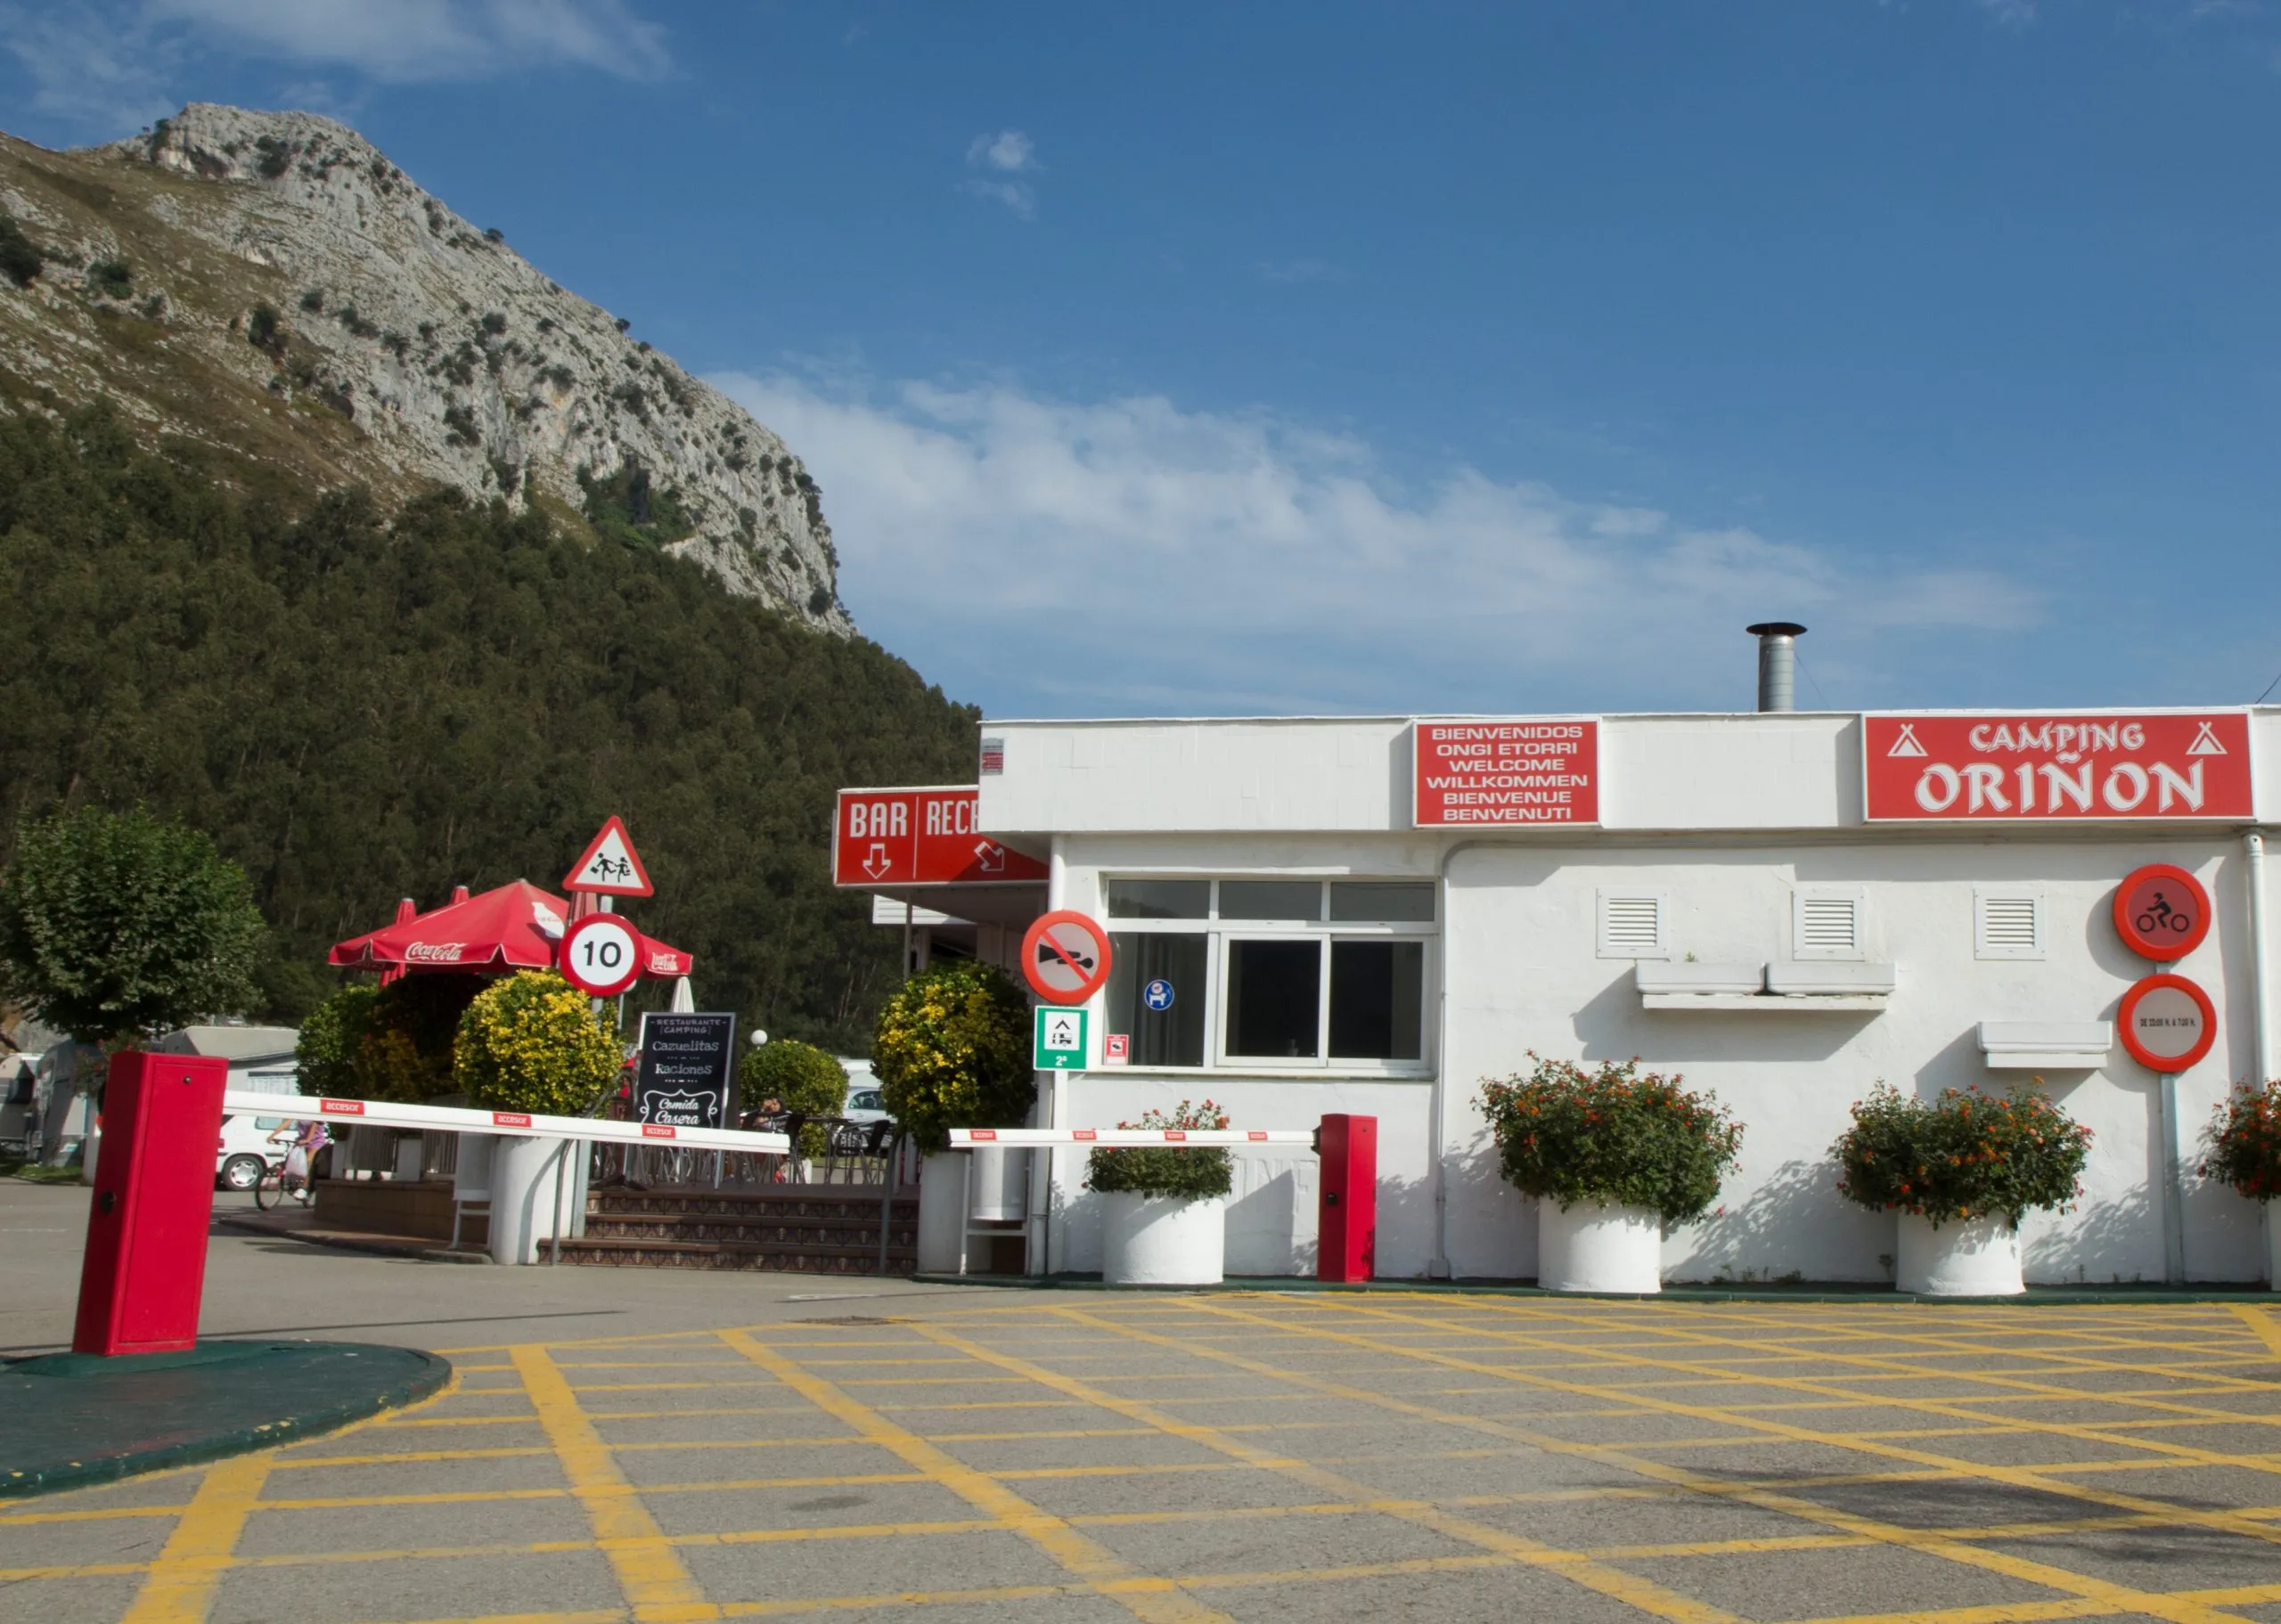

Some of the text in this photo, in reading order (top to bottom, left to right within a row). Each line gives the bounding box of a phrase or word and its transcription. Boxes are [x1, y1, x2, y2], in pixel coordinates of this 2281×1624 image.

[1432, 726, 1583, 740] BIENVENIDOS
[1969, 722, 2146, 753] CAMPING
[1436, 742, 1577, 756] ONGI ETORRI
[1449, 759, 1566, 772] WELCOME
[1427, 774, 1588, 788] WILLKOMMEN
[1915, 751, 2204, 813] ORIÑON
[1443, 791, 1572, 805] BIENVENUE
[849, 802, 908, 837] BAR
[1443, 808, 1572, 821] BENVENUTI
[584, 941, 622, 967] 10
[652, 1040, 720, 1051] Cazuelitas
[655, 1063, 714, 1075] Raciones
[658, 1098, 699, 1111] Comida
[655, 1110, 700, 1125] Casera
